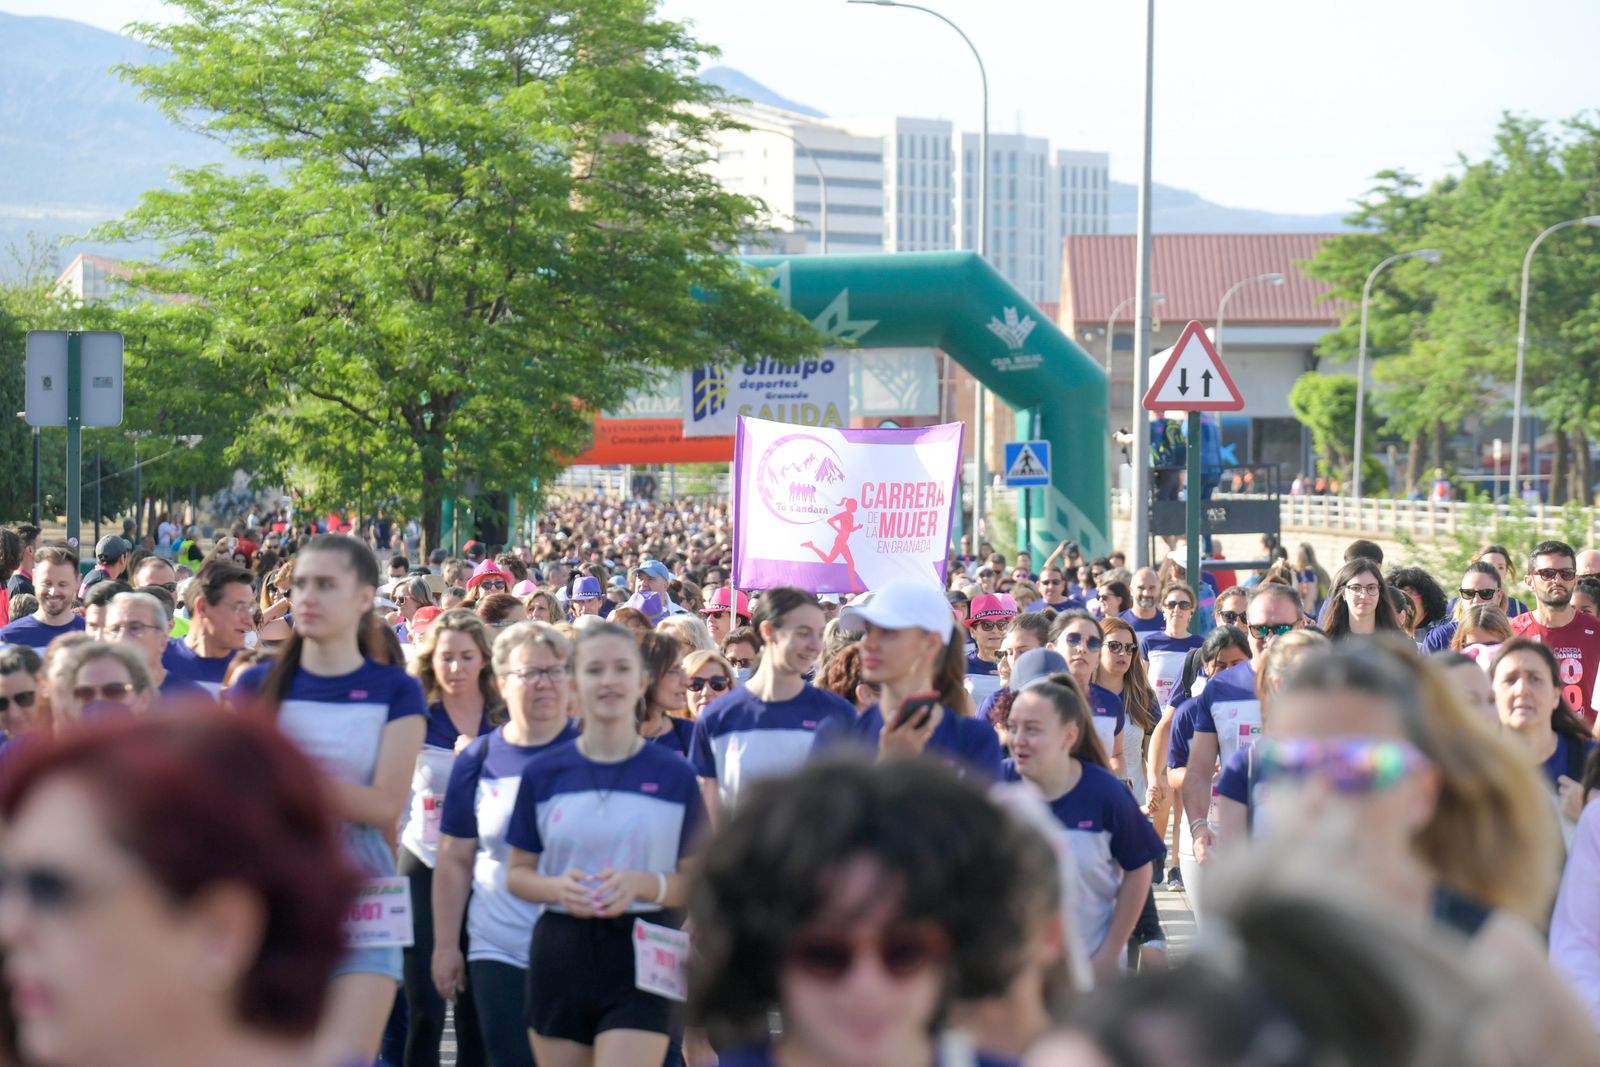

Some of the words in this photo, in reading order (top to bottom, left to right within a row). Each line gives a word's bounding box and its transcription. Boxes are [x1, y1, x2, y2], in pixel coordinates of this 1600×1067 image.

[743, 357, 834, 379] olimpo
[740, 379, 798, 390] deportes
[861, 482, 944, 509] CARRERA
[867, 511, 879, 523] DE
[879, 510, 938, 538] MUJER
[865, 527, 878, 538] LA
[876, 541, 889, 553] EN
[891, 540, 931, 553] GRANADA
